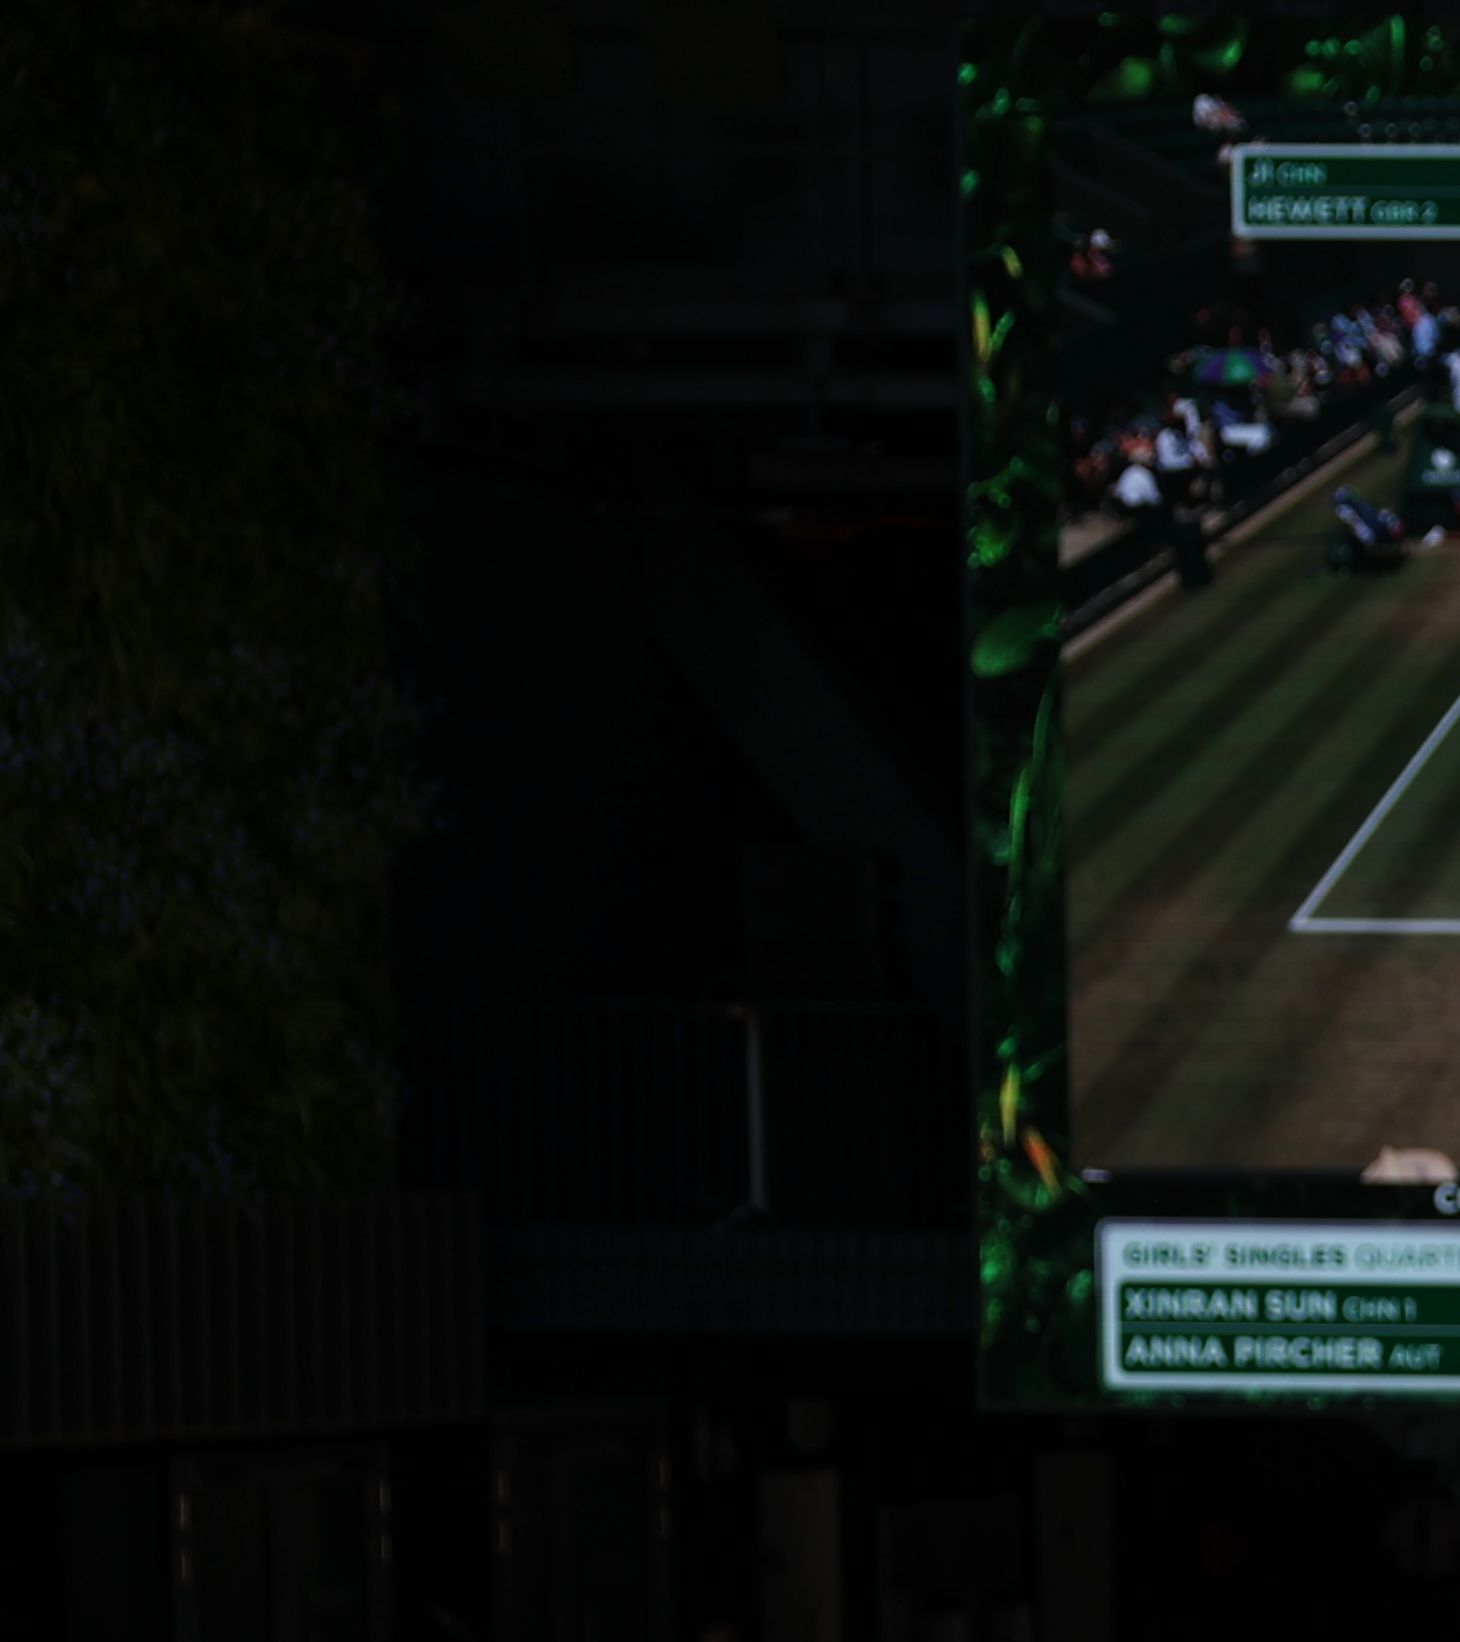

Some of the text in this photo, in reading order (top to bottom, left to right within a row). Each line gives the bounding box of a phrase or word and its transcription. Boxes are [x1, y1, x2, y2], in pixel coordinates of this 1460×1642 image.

[1248, 196, 1368, 223] HEWETT
[1224, 1242, 1345, 1271] SINGLES
[1124, 1288, 1259, 1321] XINRAN
[1264, 1290, 1337, 1322] SUN
[1343, 1296, 1398, 1322] CHN
[1402, 1297, 1418, 1323] 1
[1124, 1336, 1228, 1368] ANNA
[1234, 1337, 1383, 1370] PIRCHER
[1388, 1343, 1444, 1370] AUT
